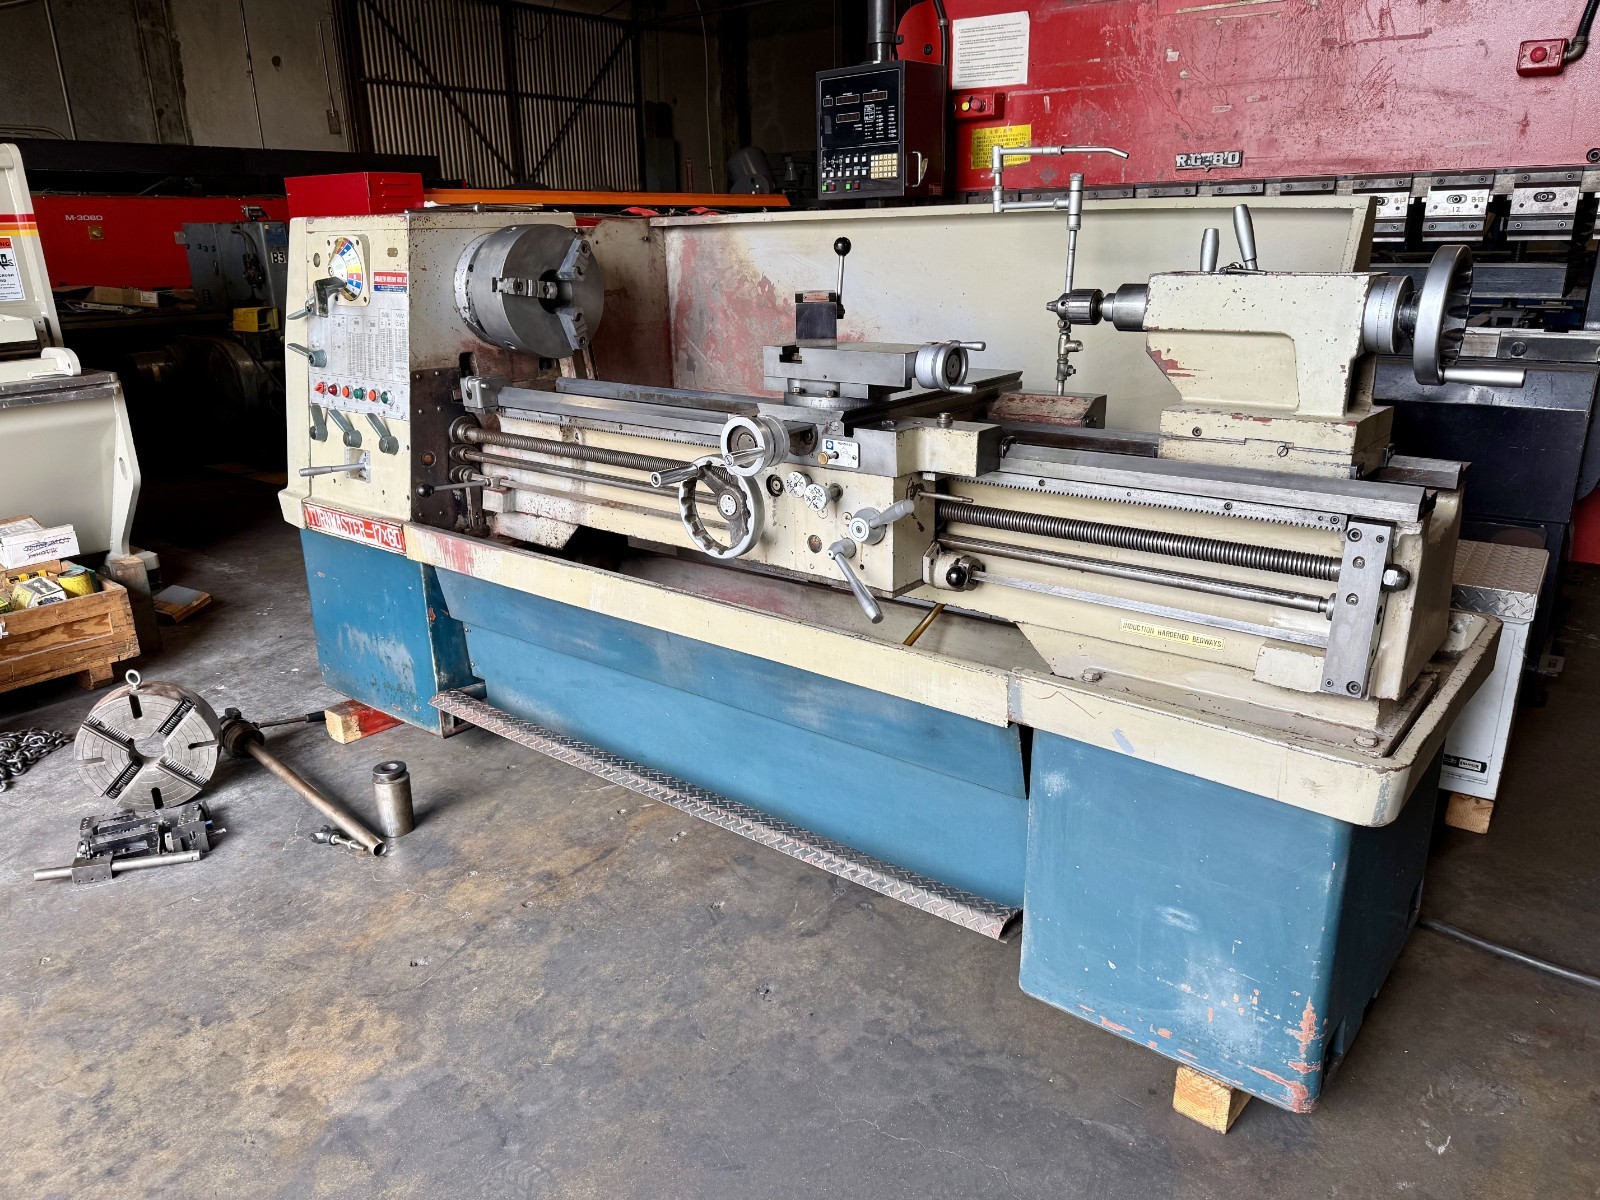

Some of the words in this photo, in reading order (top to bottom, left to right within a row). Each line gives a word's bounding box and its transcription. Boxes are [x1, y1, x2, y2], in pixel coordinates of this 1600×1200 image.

[1122, 622, 1154, 634] INDUCTION
[1157, 630, 1189, 641] HARDENED
[1192, 635, 1222, 648] BEDWAYS
